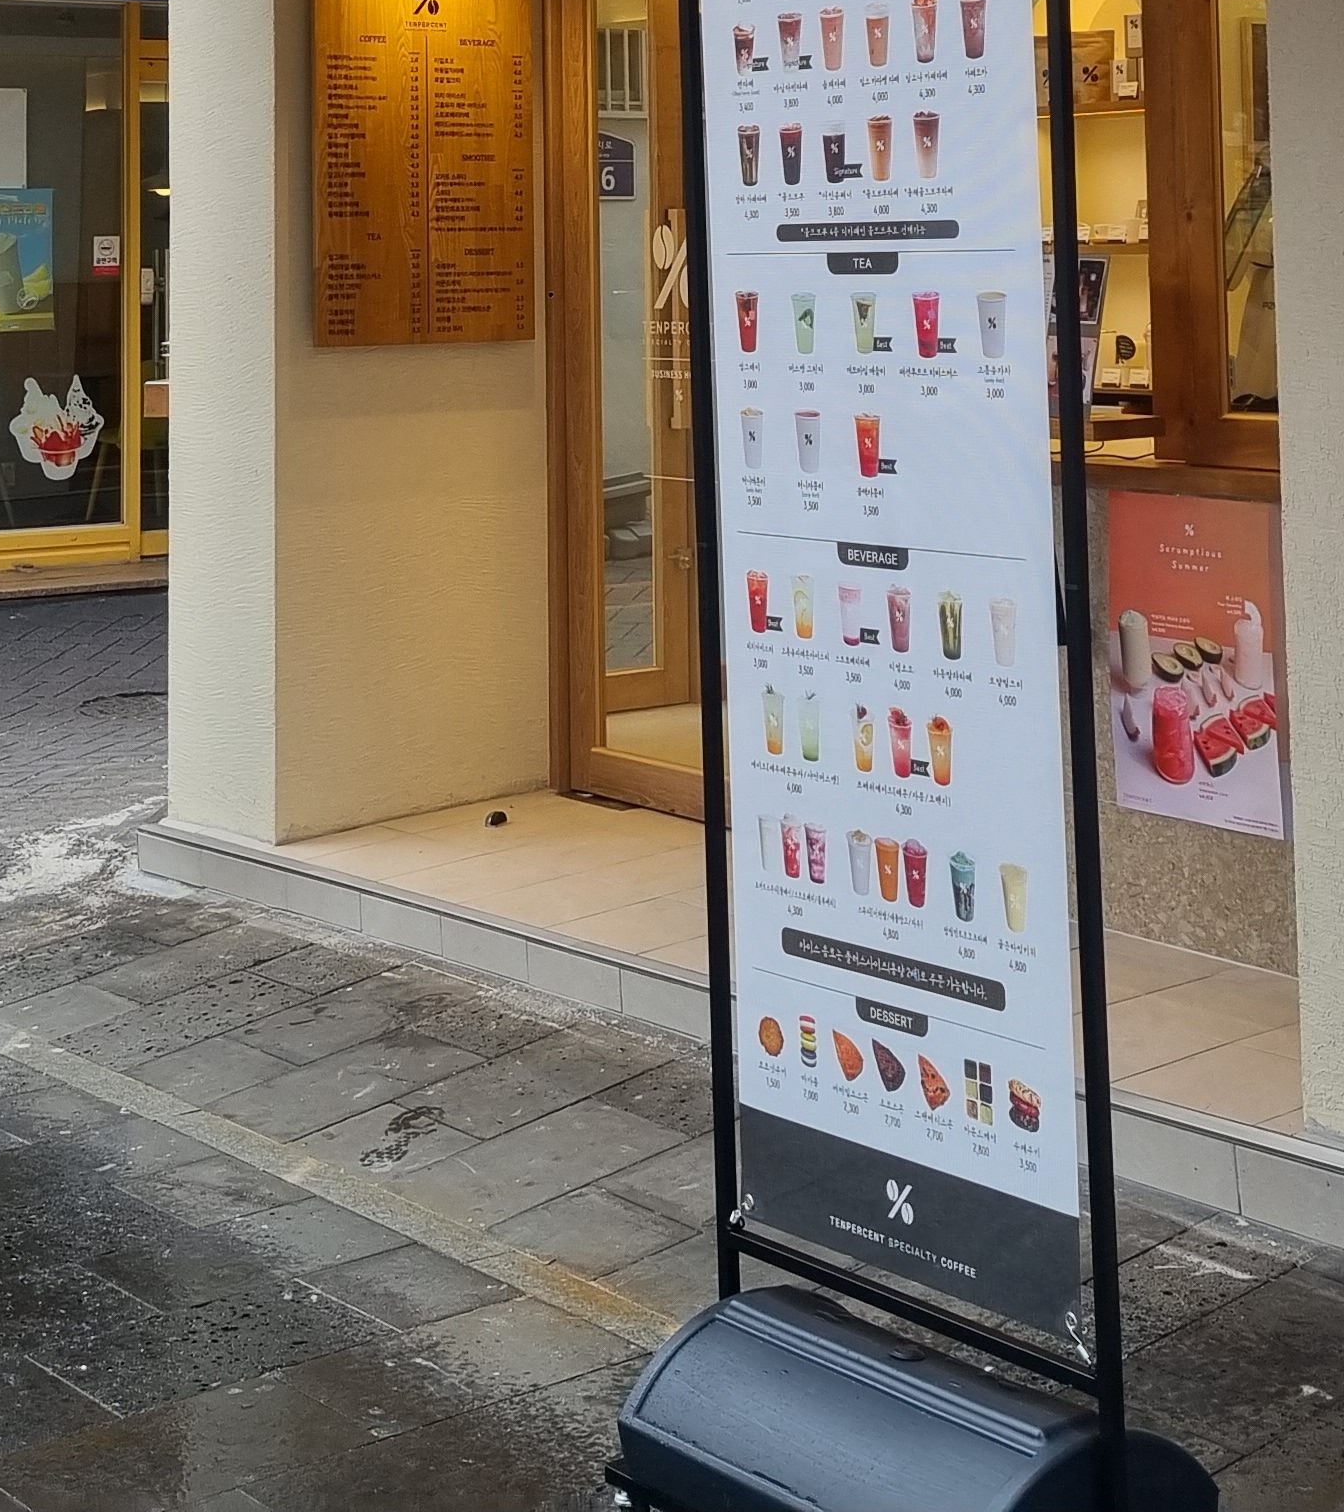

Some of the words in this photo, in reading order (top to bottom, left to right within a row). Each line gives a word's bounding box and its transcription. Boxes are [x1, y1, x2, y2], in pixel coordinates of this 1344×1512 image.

[405, 21, 448, 29] TENPERCENT
[359, 35, 387, 44] COFFEE
[459, 39, 497, 47] BEVERAGE
[461, 154, 496, 162] SMOOTHIE
[873, 204, 890, 215] 4,000
[367, 233, 382, 241] TEA
[464, 248, 495, 256] DESSERT
[852, 258, 873, 269] TEA
[799, 381, 815, 392] 3,000
[858, 383, 875, 395] 3,000
[921, 385, 938, 396] 3,000
[986, 388, 1005, 399] 3,000
[863, 505, 879, 516] 3,500
[1159, 543, 1222, 559] Scrumptious
[847, 549, 898, 565] BEVERAGE
[1171, 560, 1210, 573] Summer
[798, 664, 814, 676] 3,500
[846, 671, 862, 683] 3,500
[894, 680, 911, 691] 4,000
[945, 687, 963, 699] 4,000
[999, 695, 1017, 707] 4,000
[786, 783, 803, 795] 4,000
[869, 1006, 914, 1029] DESSERT
[1019, 1159, 1037, 1173] 3,500
[829, 1215, 886, 1245] TENPERCENT
[888, 1237, 938, 1264] SPECIALTY
[940, 1257, 977, 1279] COFFEE
